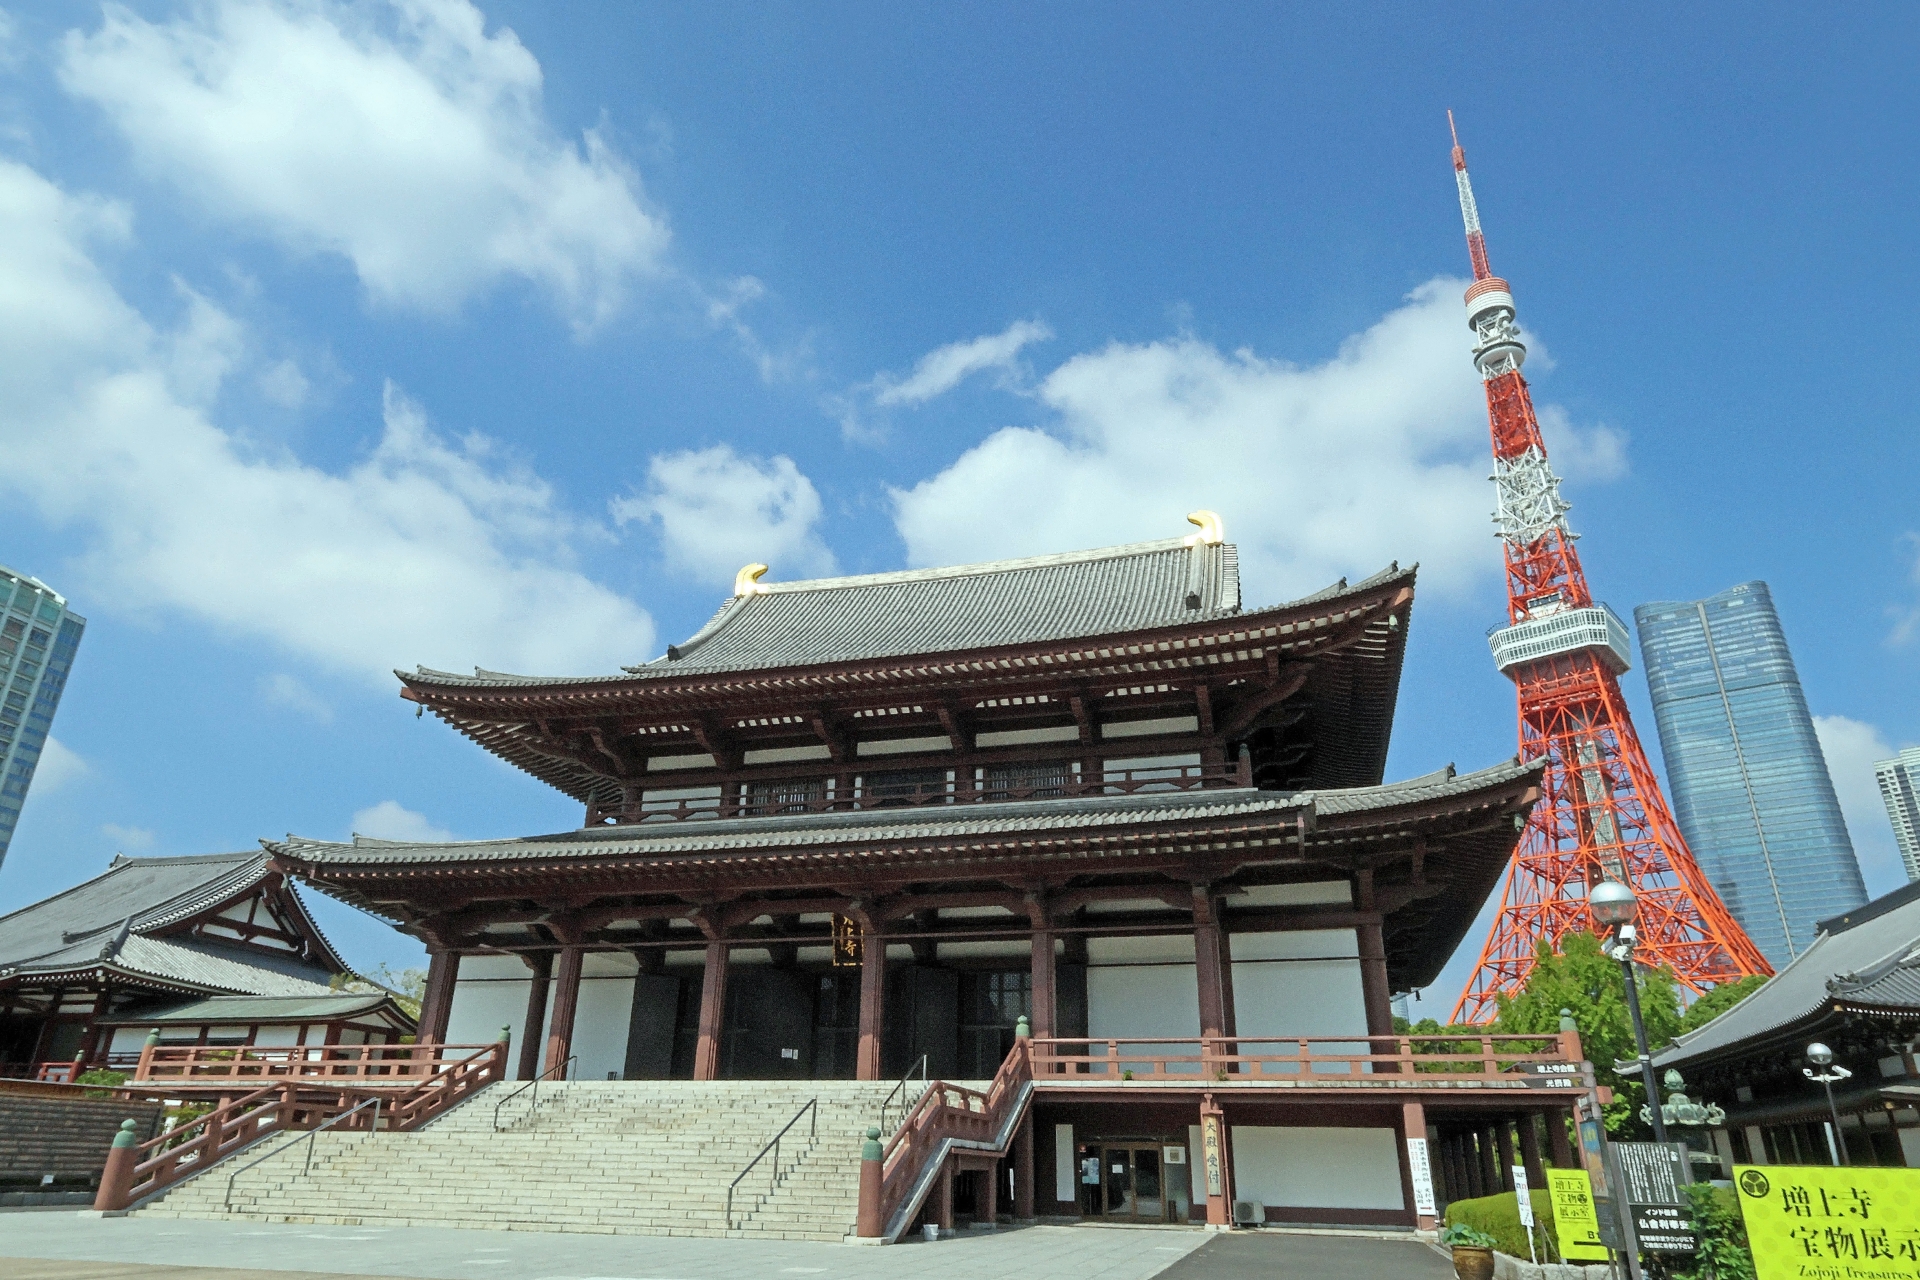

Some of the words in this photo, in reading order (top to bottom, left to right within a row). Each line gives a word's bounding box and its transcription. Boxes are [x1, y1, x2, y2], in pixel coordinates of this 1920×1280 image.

[1555, 1180, 1584, 1191] 増上寺
[1780, 1186, 1872, 1219] 増上寺
[1789, 1226, 1920, 1261] 宝物展示
[1797, 1264, 1840, 1280] Zojoji
[1842, 1266, 1913, 1280] Treasures
